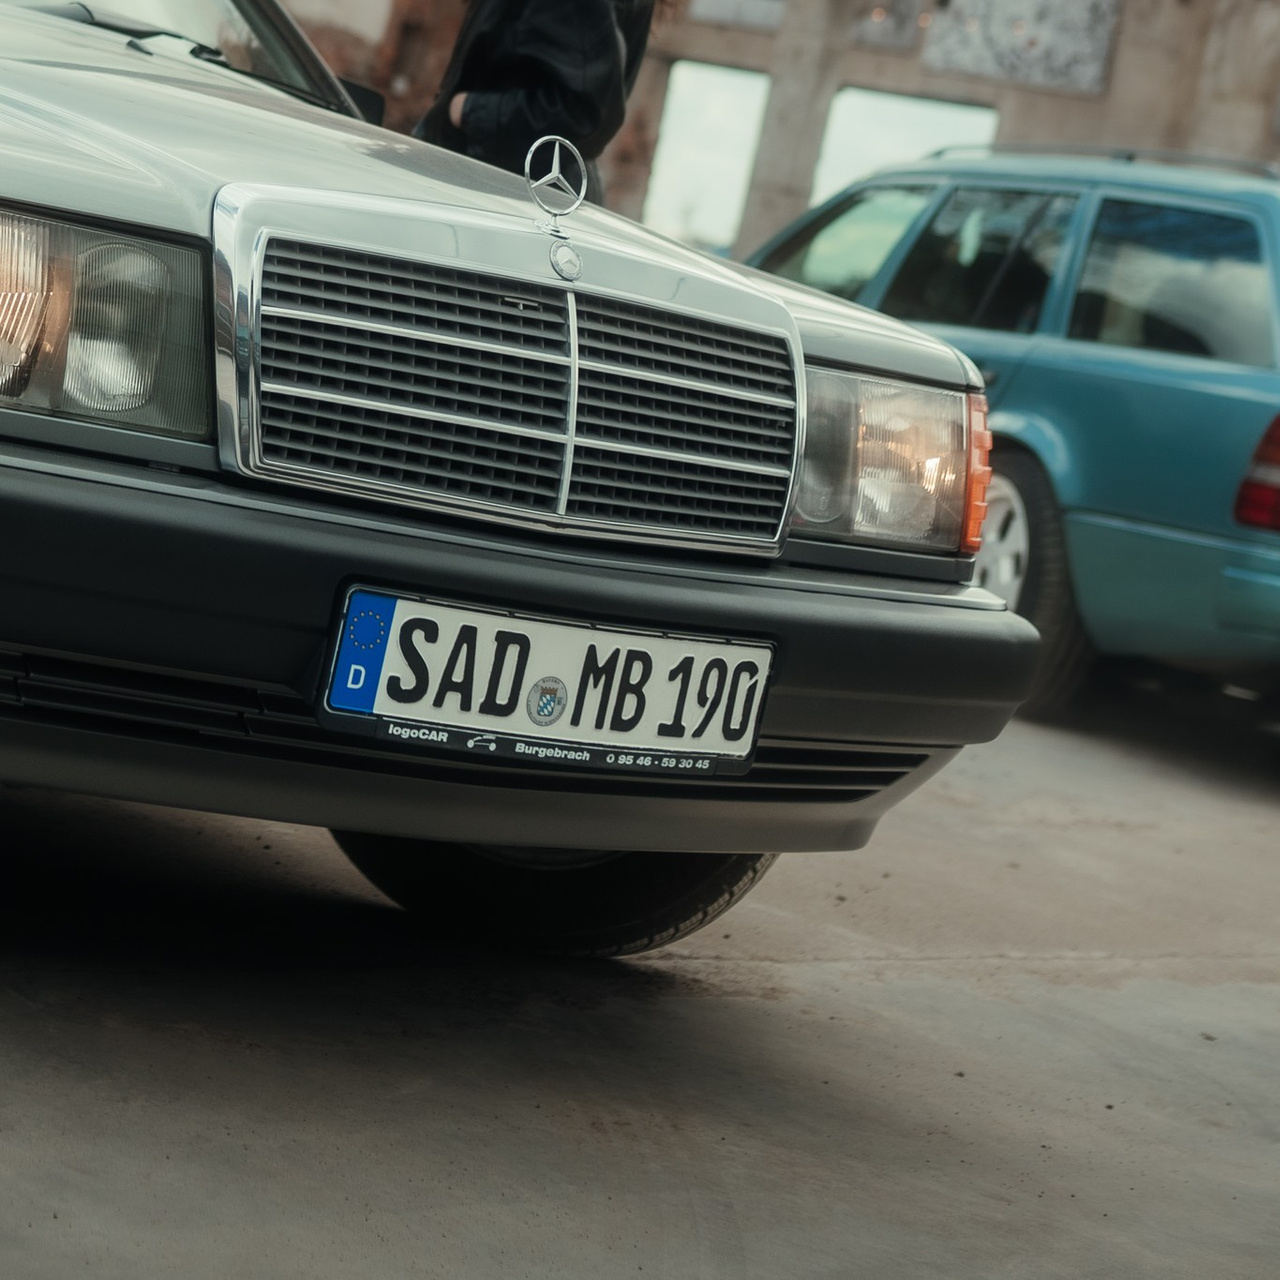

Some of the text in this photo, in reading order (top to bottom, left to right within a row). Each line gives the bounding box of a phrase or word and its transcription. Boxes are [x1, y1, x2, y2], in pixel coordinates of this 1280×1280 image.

[347, 664, 366, 689] D
[387, 617, 759, 742] SAD MB 190
[388, 723, 590, 761] logoCAR Burgebrach
[606, 753, 615, 763] 0
[617, 754, 634, 765] 95
[636, 756, 652, 766] 46
[661, 758, 676, 767] 59
[678, 759, 693, 768] 30
[695, 760, 710, 769] 45
